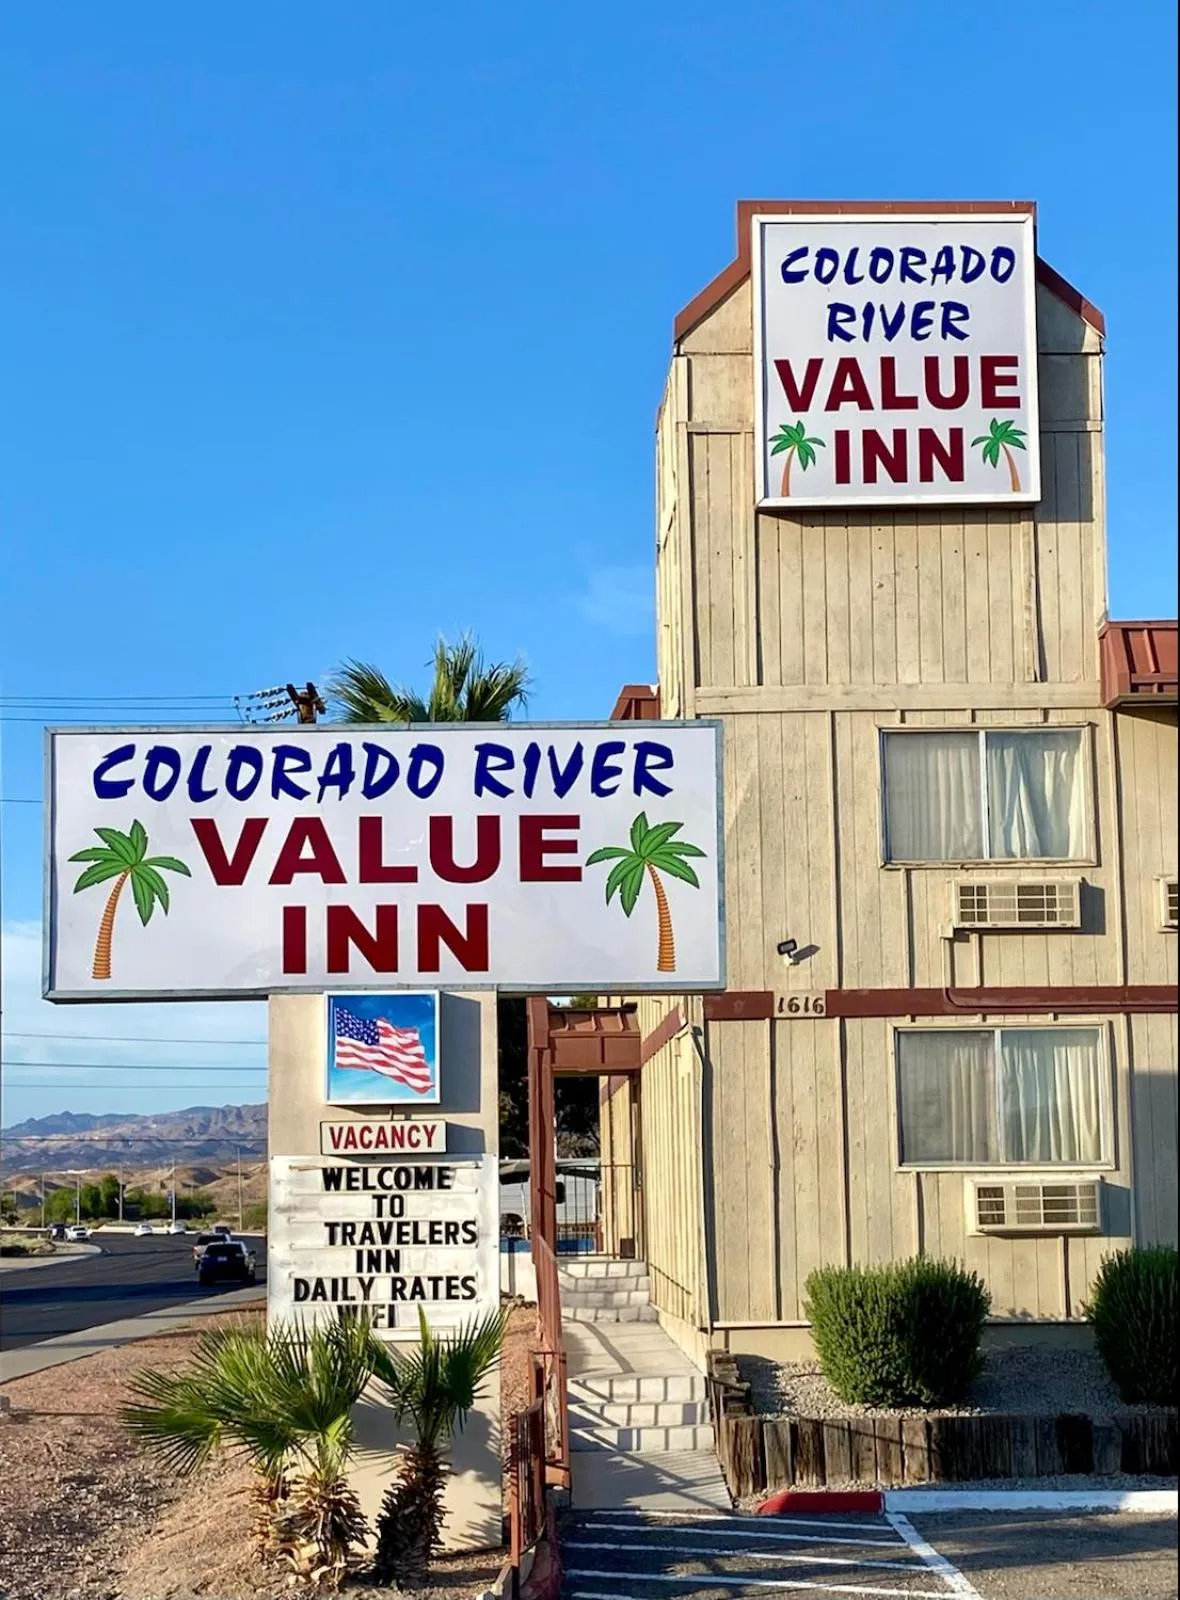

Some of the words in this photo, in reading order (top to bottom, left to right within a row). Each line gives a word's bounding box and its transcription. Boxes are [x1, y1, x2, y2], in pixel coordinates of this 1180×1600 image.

[780, 245, 1016, 285] COLORADO
[827, 301, 970, 342] RIVER
[773, 355, 1021, 413] VALUE
[834, 427, 965, 484] INN
[93, 742, 445, 803] COLORADO
[474, 741, 674, 798] RIVER
[190, 814, 582, 887] VALUE
[282, 903, 490, 975] INN
[777, 996, 824, 1014] 1616
[328, 1124, 437, 1150] VACANCY
[322, 1166, 452, 1190] WELCOME
[371, 1194, 405, 1218] TO
[324, 1221, 477, 1246] TRAVELERS
[355, 1250, 401, 1273] INN
[293, 1278, 376, 1302] DAILY
[391, 1275, 477, 1301] RATES
